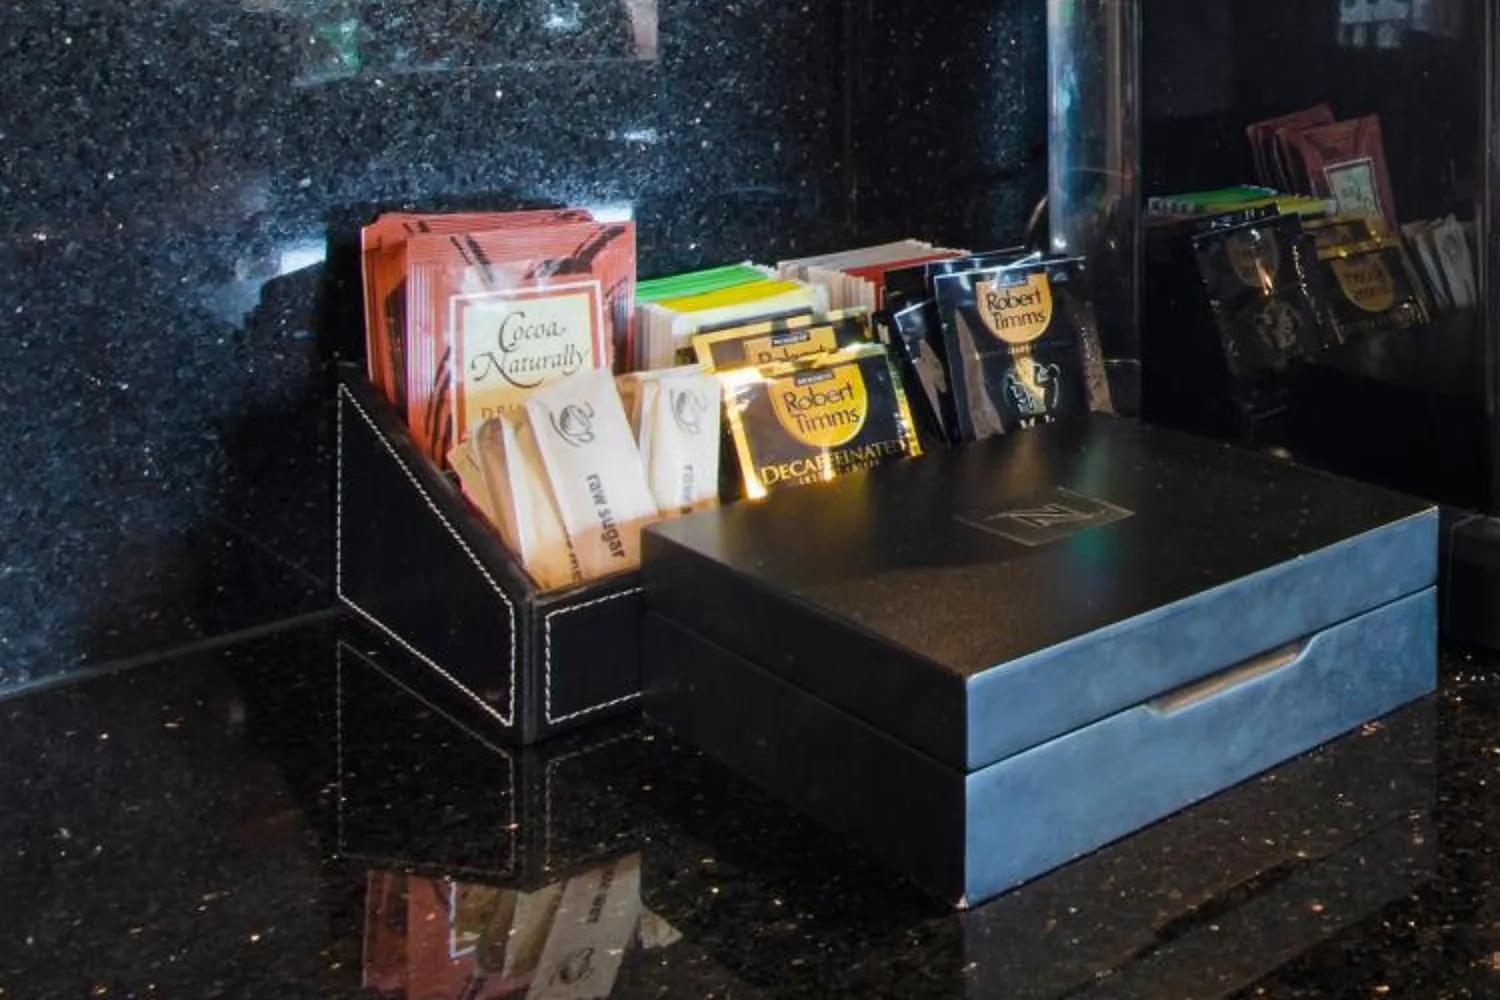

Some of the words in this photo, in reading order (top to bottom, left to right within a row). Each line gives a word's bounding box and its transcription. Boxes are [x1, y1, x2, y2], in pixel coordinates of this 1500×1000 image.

[986, 288, 1041, 311] Robert
[498, 311, 566, 352] Cocoa
[993, 310, 1045, 330] Timms
[470, 343, 589, 388] Naturally
[783, 380, 853, 412] Robert
[792, 407, 861, 434] Timms
[586, 473, 608, 506] raw
[598, 509, 625, 558] sugar
